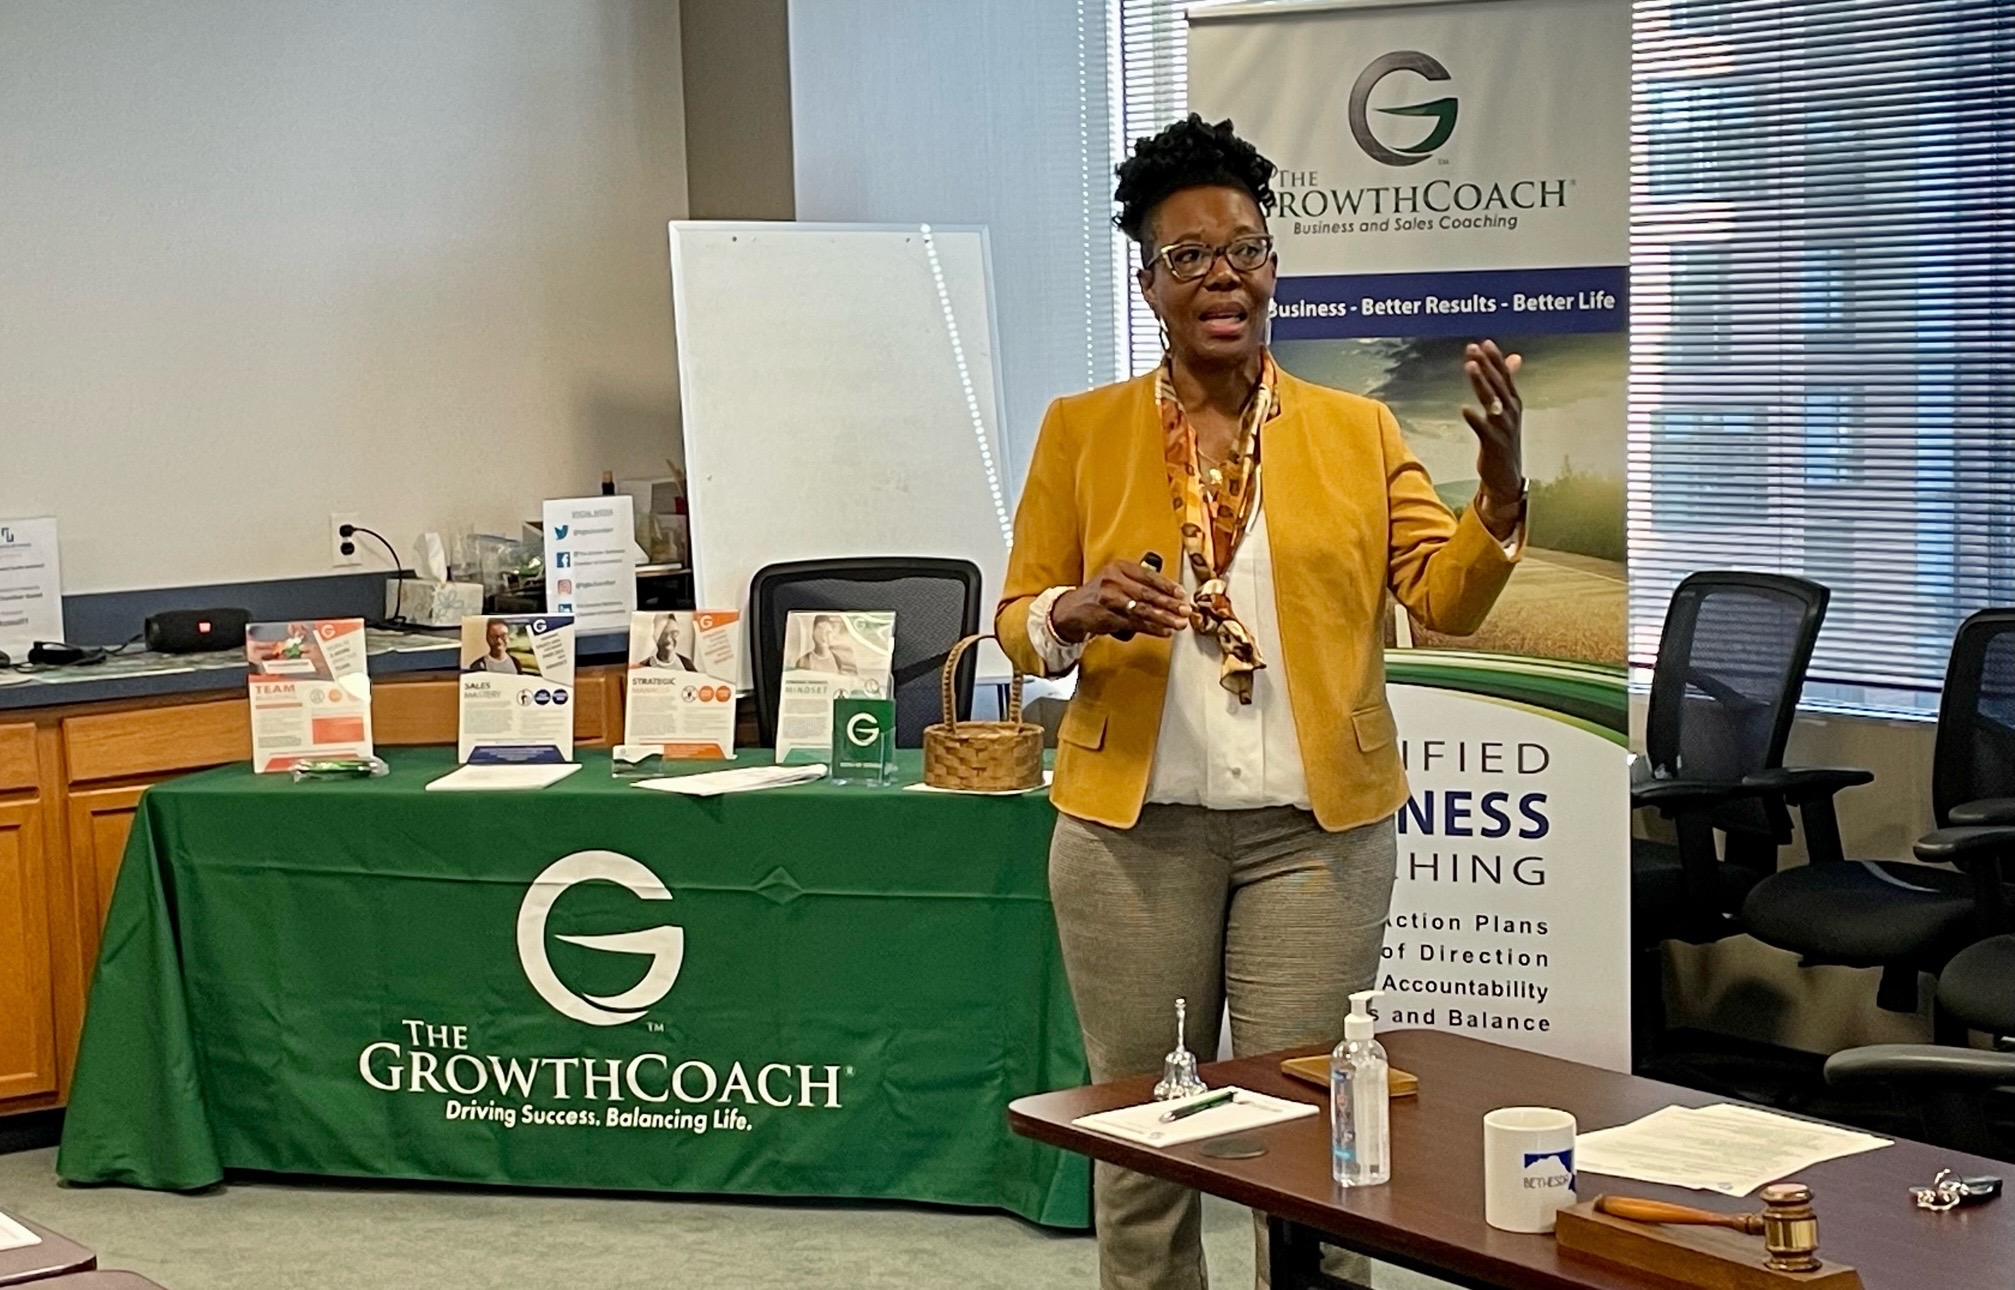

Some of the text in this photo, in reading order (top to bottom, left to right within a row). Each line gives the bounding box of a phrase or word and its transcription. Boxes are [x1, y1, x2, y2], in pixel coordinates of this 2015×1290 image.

[1279, 170, 1318, 188] THE
[1266, 179, 1567, 218] ROWTHCOACH
[1293, 214, 1518, 235] Business and Sales Coaching
[1361, 297, 1421, 316] Better
[1425, 295, 1497, 315] Results
[1513, 293, 1575, 312] Better
[1578, 290, 1616, 310] Life
[1402, 740, 1550, 774] IFIED
[1397, 790, 1550, 839] NESS
[1409, 852, 1546, 886] HING
[1475, 914, 1548, 935] Plans
[1381, 943, 1548, 967] of Direction
[1382, 974, 1549, 1004] Accountability
[402, 1019, 468, 1050] THE
[1391, 1008, 1435, 1025] and
[1448, 1009, 1551, 1032] Balance
[446, 1099, 516, 1128] Driving
[605, 1106, 708, 1134] Balancing
[713, 1107, 753, 1131] Life.
